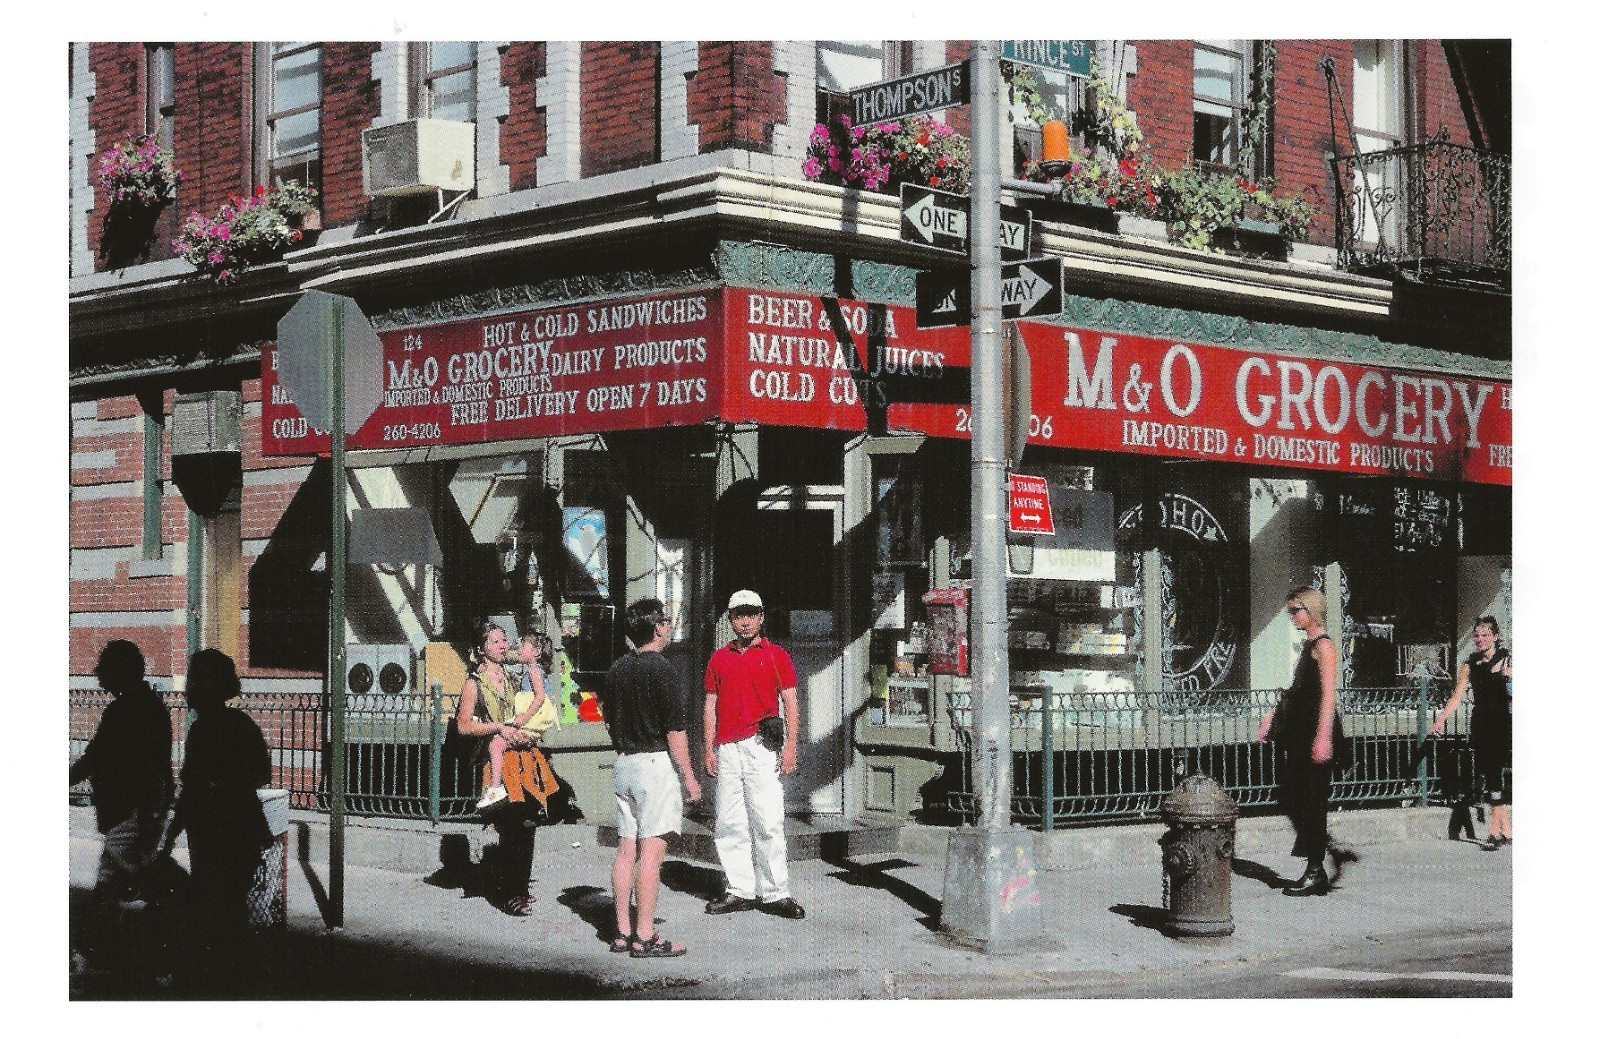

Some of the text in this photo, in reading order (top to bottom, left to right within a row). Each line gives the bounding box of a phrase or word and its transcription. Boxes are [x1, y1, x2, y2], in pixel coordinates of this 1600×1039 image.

[1001, 40, 1085, 68] RINCE ST
[852, 69, 962, 124] THOMPSON S
[920, 206, 1020, 247] ONE AY
[483, 297, 708, 348] HOT & COLD SANDWICHES
[748, 294, 899, 338] BEER & SODA
[403, 334, 423, 351] 124
[552, 336, 708, 377] DAIRY PRODUCTS
[748, 332, 946, 379] NATURAL JUICES
[387, 340, 554, 390] M&O GROCERY
[383, 373, 553, 408] IMPORTED & DOMESTIC PRODUCTS
[451, 377, 708, 427] FREE DELIVERY OPEN 7 DAYS
[750, 368, 887, 409] COLD CUTS
[1063, 331, 1495, 449] M&O GROCERY
[272, 417, 308, 439] COLD
[383, 422, 442, 441] 260-4206
[1122, 419, 1435, 474] IMPORTED & DOMESTIC PRODUCTS
[1013, 497, 1045, 510] ANYTIME
